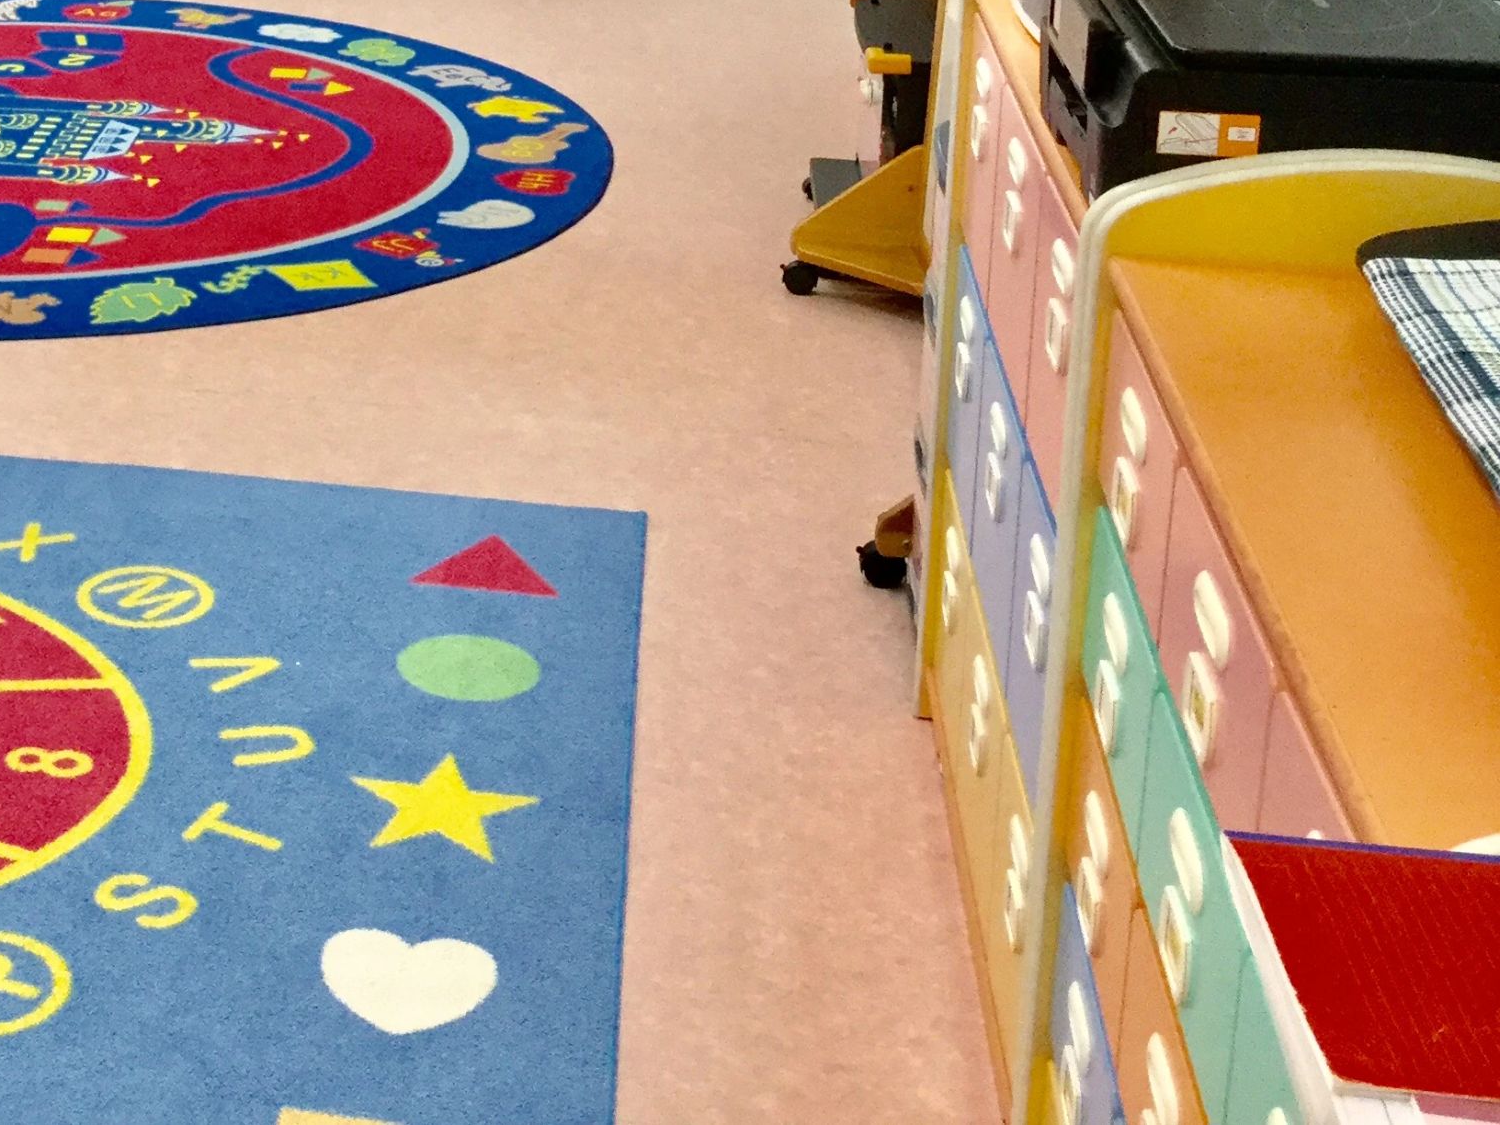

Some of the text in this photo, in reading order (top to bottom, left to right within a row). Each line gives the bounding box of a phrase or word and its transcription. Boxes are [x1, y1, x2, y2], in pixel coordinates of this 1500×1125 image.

[190, 657, 282, 694] V
[6, 746, 93, 778] 8
[220, 725, 316, 767] U
[182, 801, 283, 851] T
[94, 873, 199, 929] S
